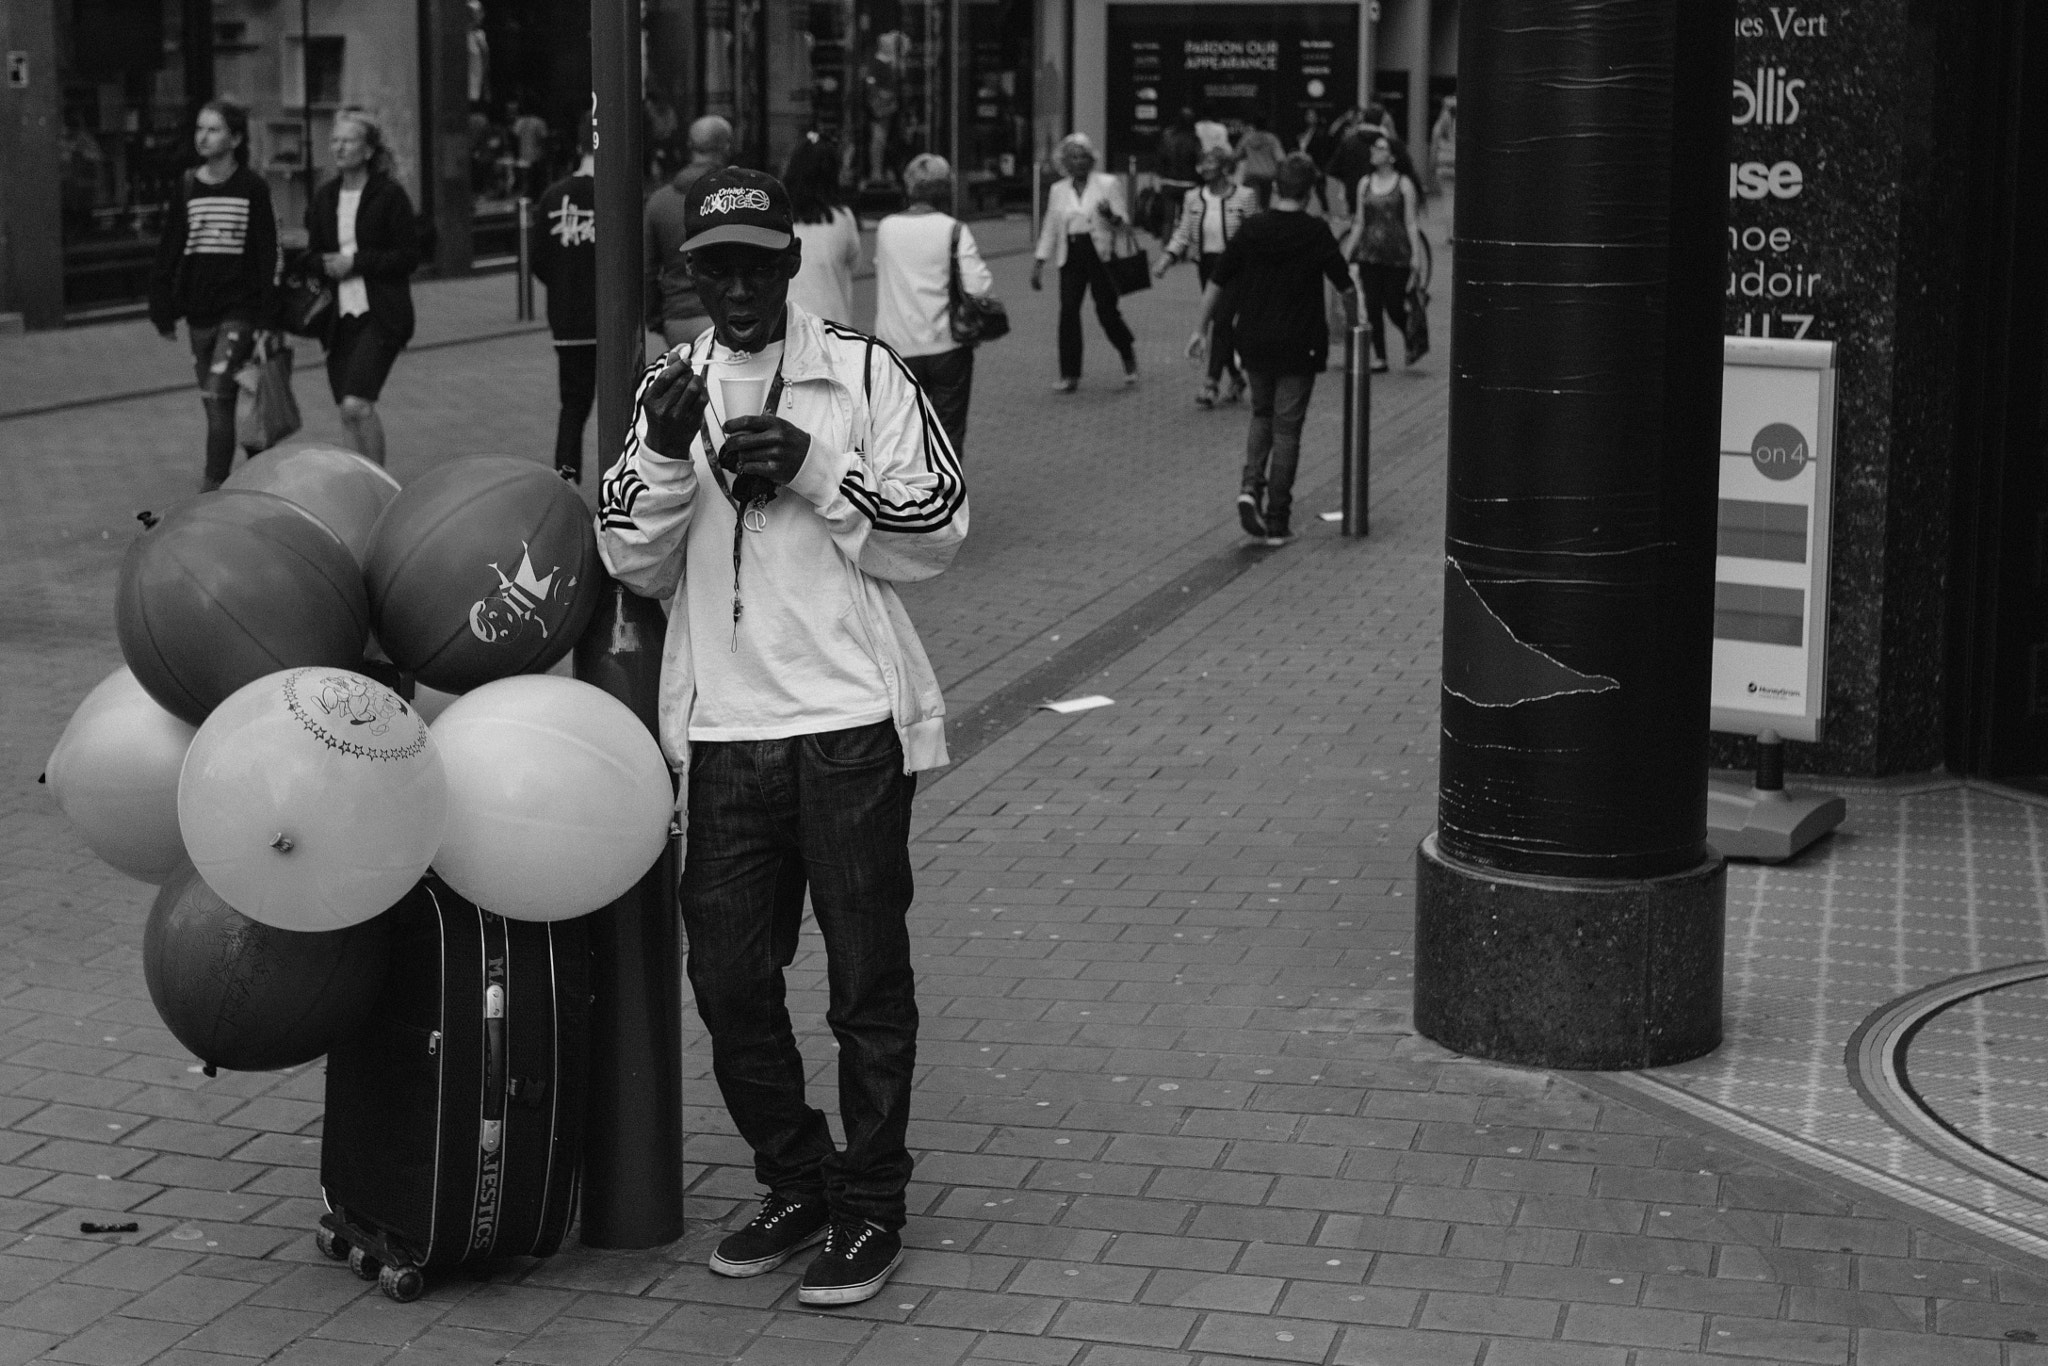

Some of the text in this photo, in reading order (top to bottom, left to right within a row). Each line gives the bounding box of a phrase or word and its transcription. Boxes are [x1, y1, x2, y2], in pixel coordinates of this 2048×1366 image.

[1769, 7, 1828, 40] Vert
[1184, 40, 1279, 54] PARDON OUR
[1184, 56, 1278, 70] APPEARANCE
[1756, 442, 1805, 465] on 4
